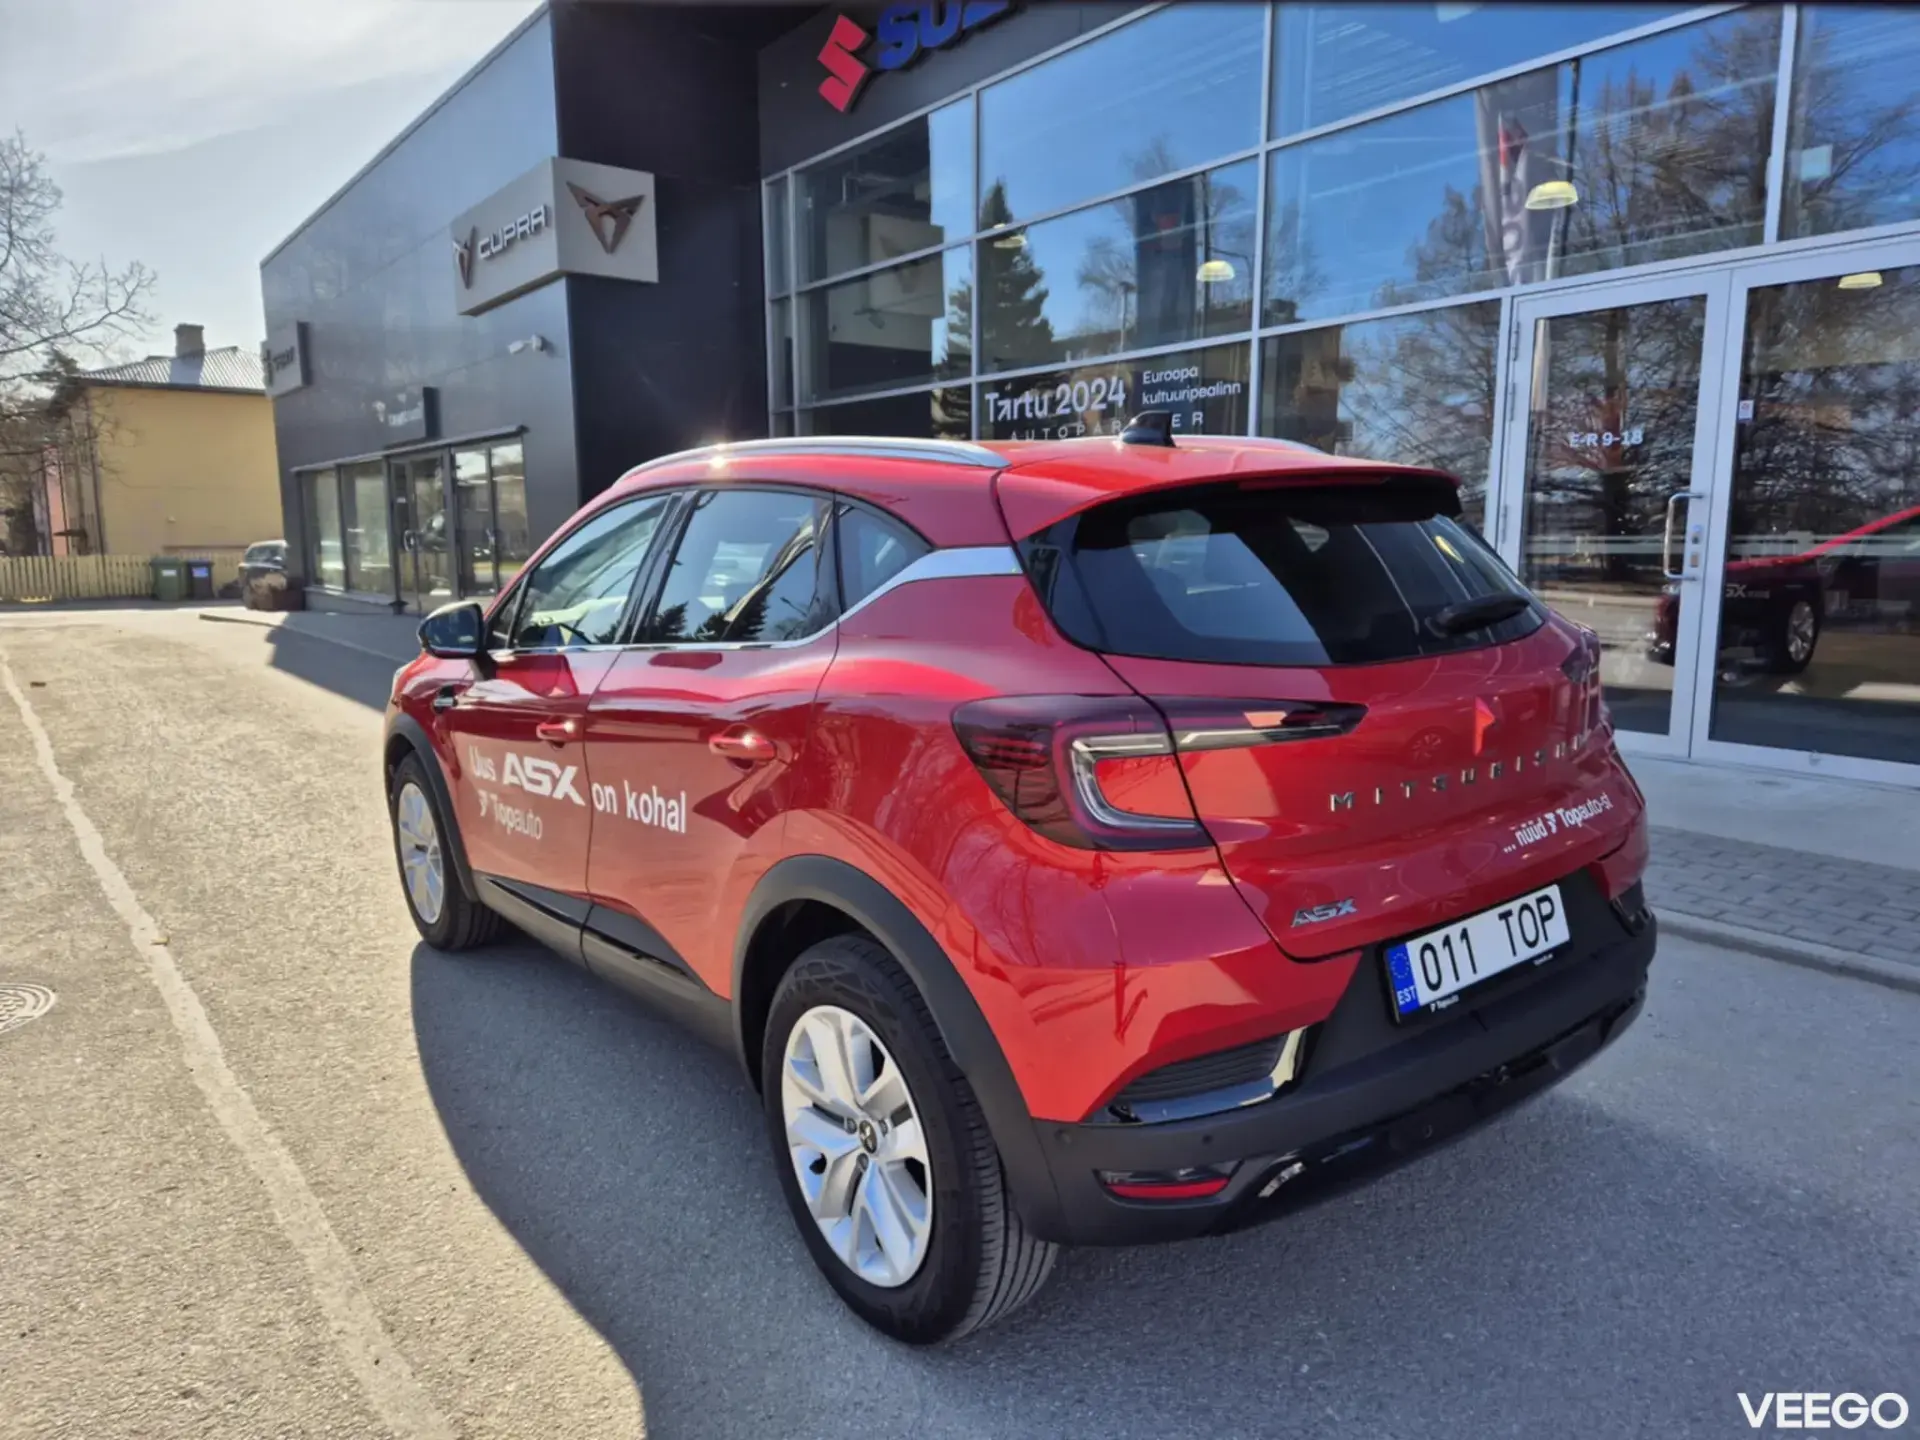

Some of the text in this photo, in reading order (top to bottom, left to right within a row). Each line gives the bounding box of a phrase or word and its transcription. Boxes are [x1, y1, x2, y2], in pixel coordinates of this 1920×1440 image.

[478, 203, 549, 260] CUPRA
[1055, 375, 1126, 415] 2024
[1142, 366, 1199, 385] Euroopa
[1142, 381, 1241, 405] kultuuripealinn
[469, 745, 686, 833] Uus ASX on kohal
[490, 793, 543, 840] Topauto
[1291, 897, 1357, 928] ASX
[1420, 894, 1555, 991] 011 TOP
[1397, 985, 1417, 1005] EST
